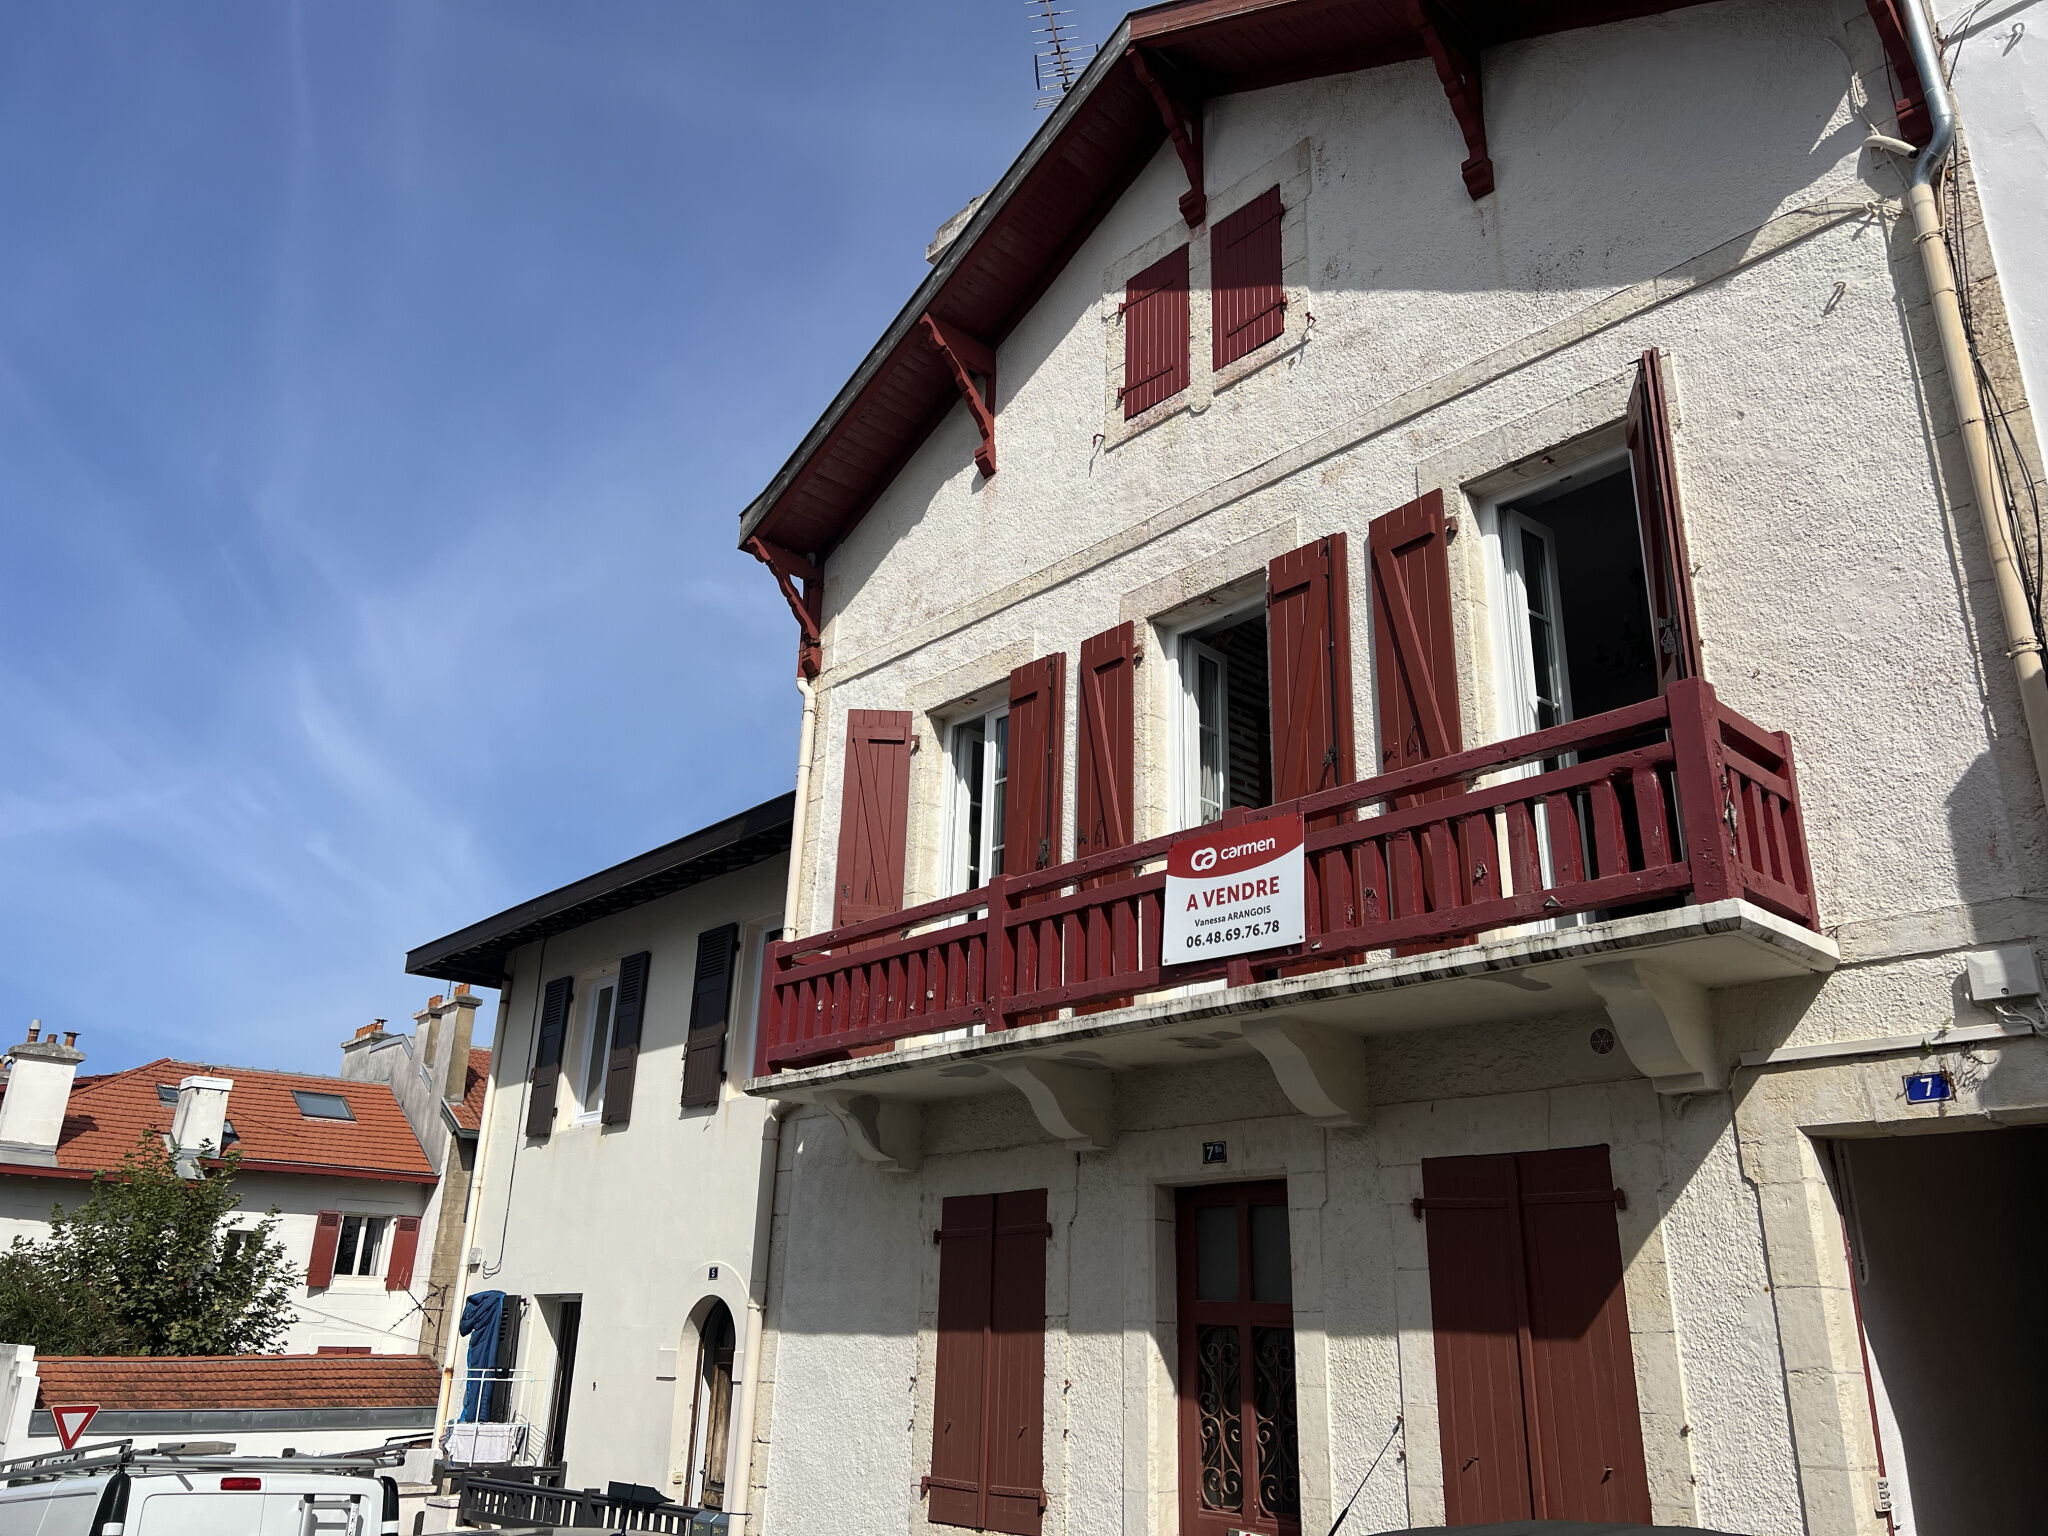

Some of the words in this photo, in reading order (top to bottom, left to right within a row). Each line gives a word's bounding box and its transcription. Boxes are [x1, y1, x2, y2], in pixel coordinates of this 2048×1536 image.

[1221, 837, 1276, 860] carmen
[1186, 894, 1199, 912] A
[1203, 875, 1280, 908] VENDRE
[1195, 915, 1226, 927] Vanessa
[1227, 905, 1271, 922] ARANGOIS
[1186, 920, 1280, 948] 06.48.69.76.78
[1920, 1078, 1933, 1097] 7
